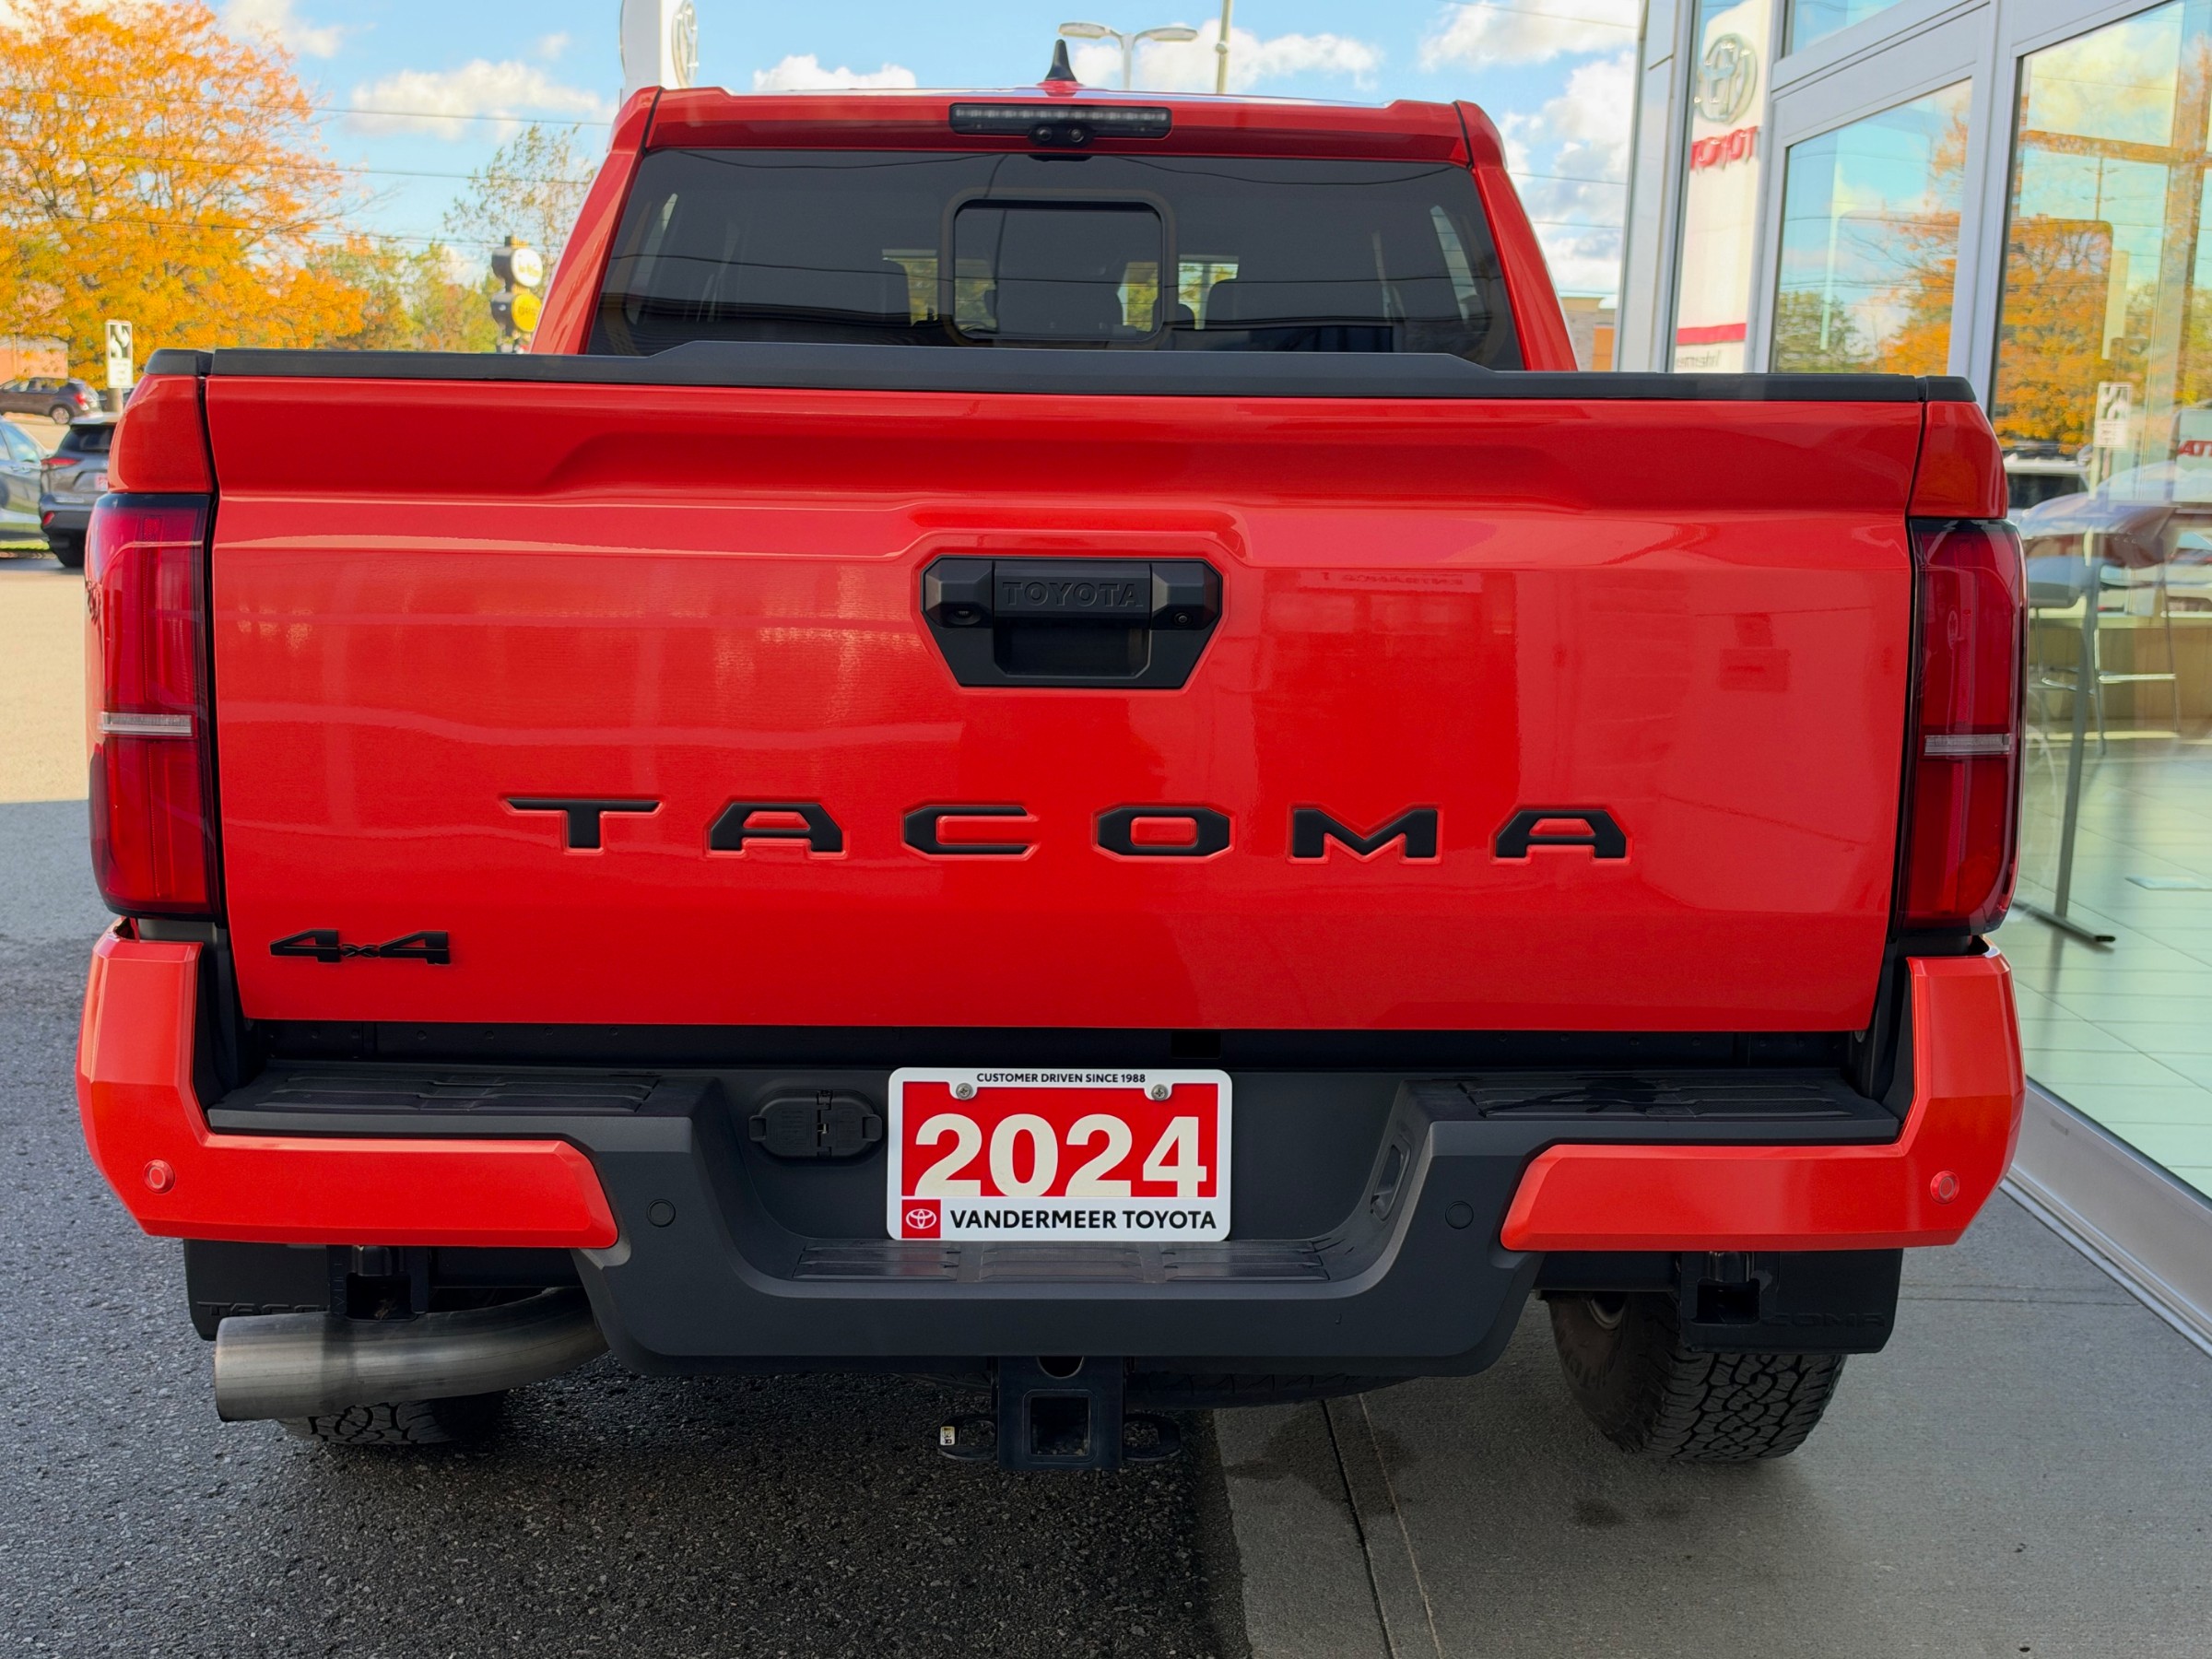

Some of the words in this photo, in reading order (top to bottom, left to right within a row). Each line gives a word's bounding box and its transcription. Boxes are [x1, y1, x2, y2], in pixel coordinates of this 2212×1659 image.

[1002, 581, 1144, 607] TOYOTA
[505, 797, 1628, 859] TACOMA
[976, 1072, 1039, 1083] CUSTOMER
[1041, 1073, 1084, 1083] DRIVEN
[1085, 1074, 1119, 1083] SINCE
[1120, 1074, 1147, 1084] 1988
[914, 1112, 1207, 1197] 2024
[949, 1209, 1118, 1229] VANDERMEER
[1122, 1210, 1217, 1230] TOYOTA
